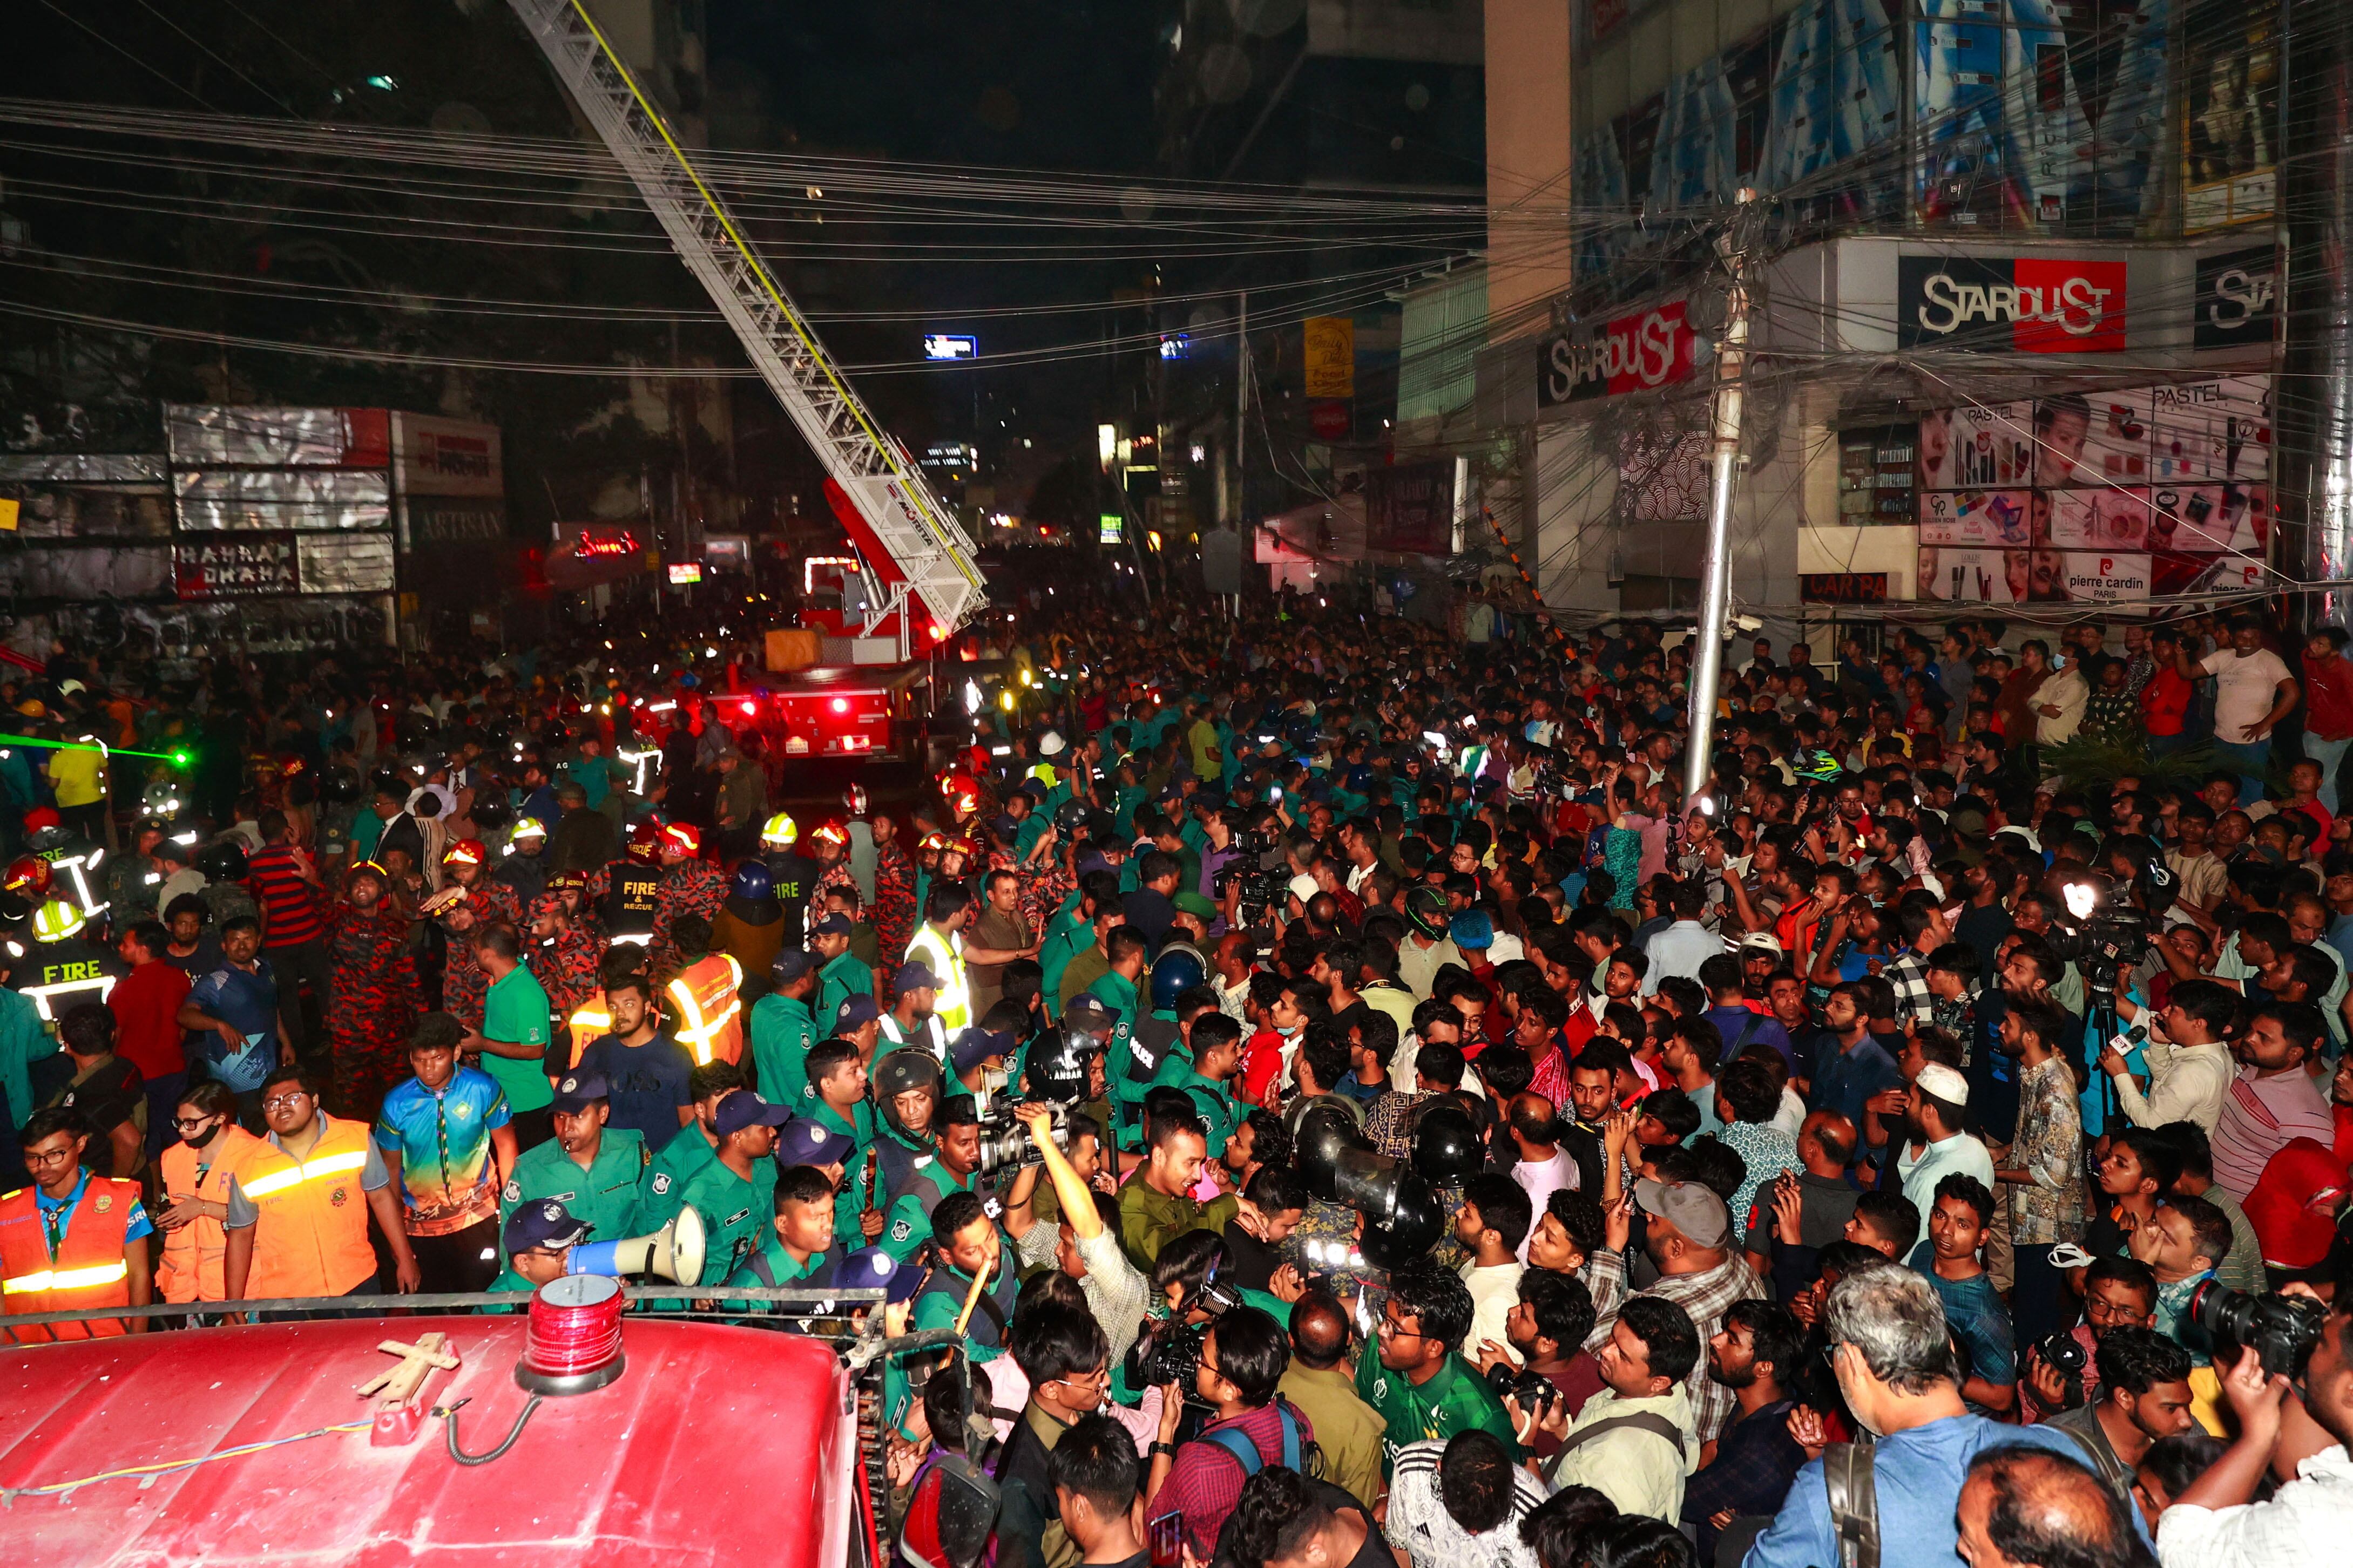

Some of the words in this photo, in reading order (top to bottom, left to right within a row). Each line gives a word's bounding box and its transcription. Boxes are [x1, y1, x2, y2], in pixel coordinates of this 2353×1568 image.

[1919, 274, 2112, 335] STARDUST
[1549, 313, 1682, 402] STARDUST
[2153, 384, 2225, 406] PASTEL
[1969, 406, 2016, 422] PASTEL
[1811, 575, 1854, 596] CAR
[2070, 575, 2104, 589] pierre
[2106, 575, 2144, 589] cardin
[2094, 589, 2117, 598] PARIS
[624, 882, 657, 896] FIRE
[774, 882, 799, 899] IRE
[43, 960, 102, 985] FIRE
[1054, 1069, 1083, 1080] ANSAR
